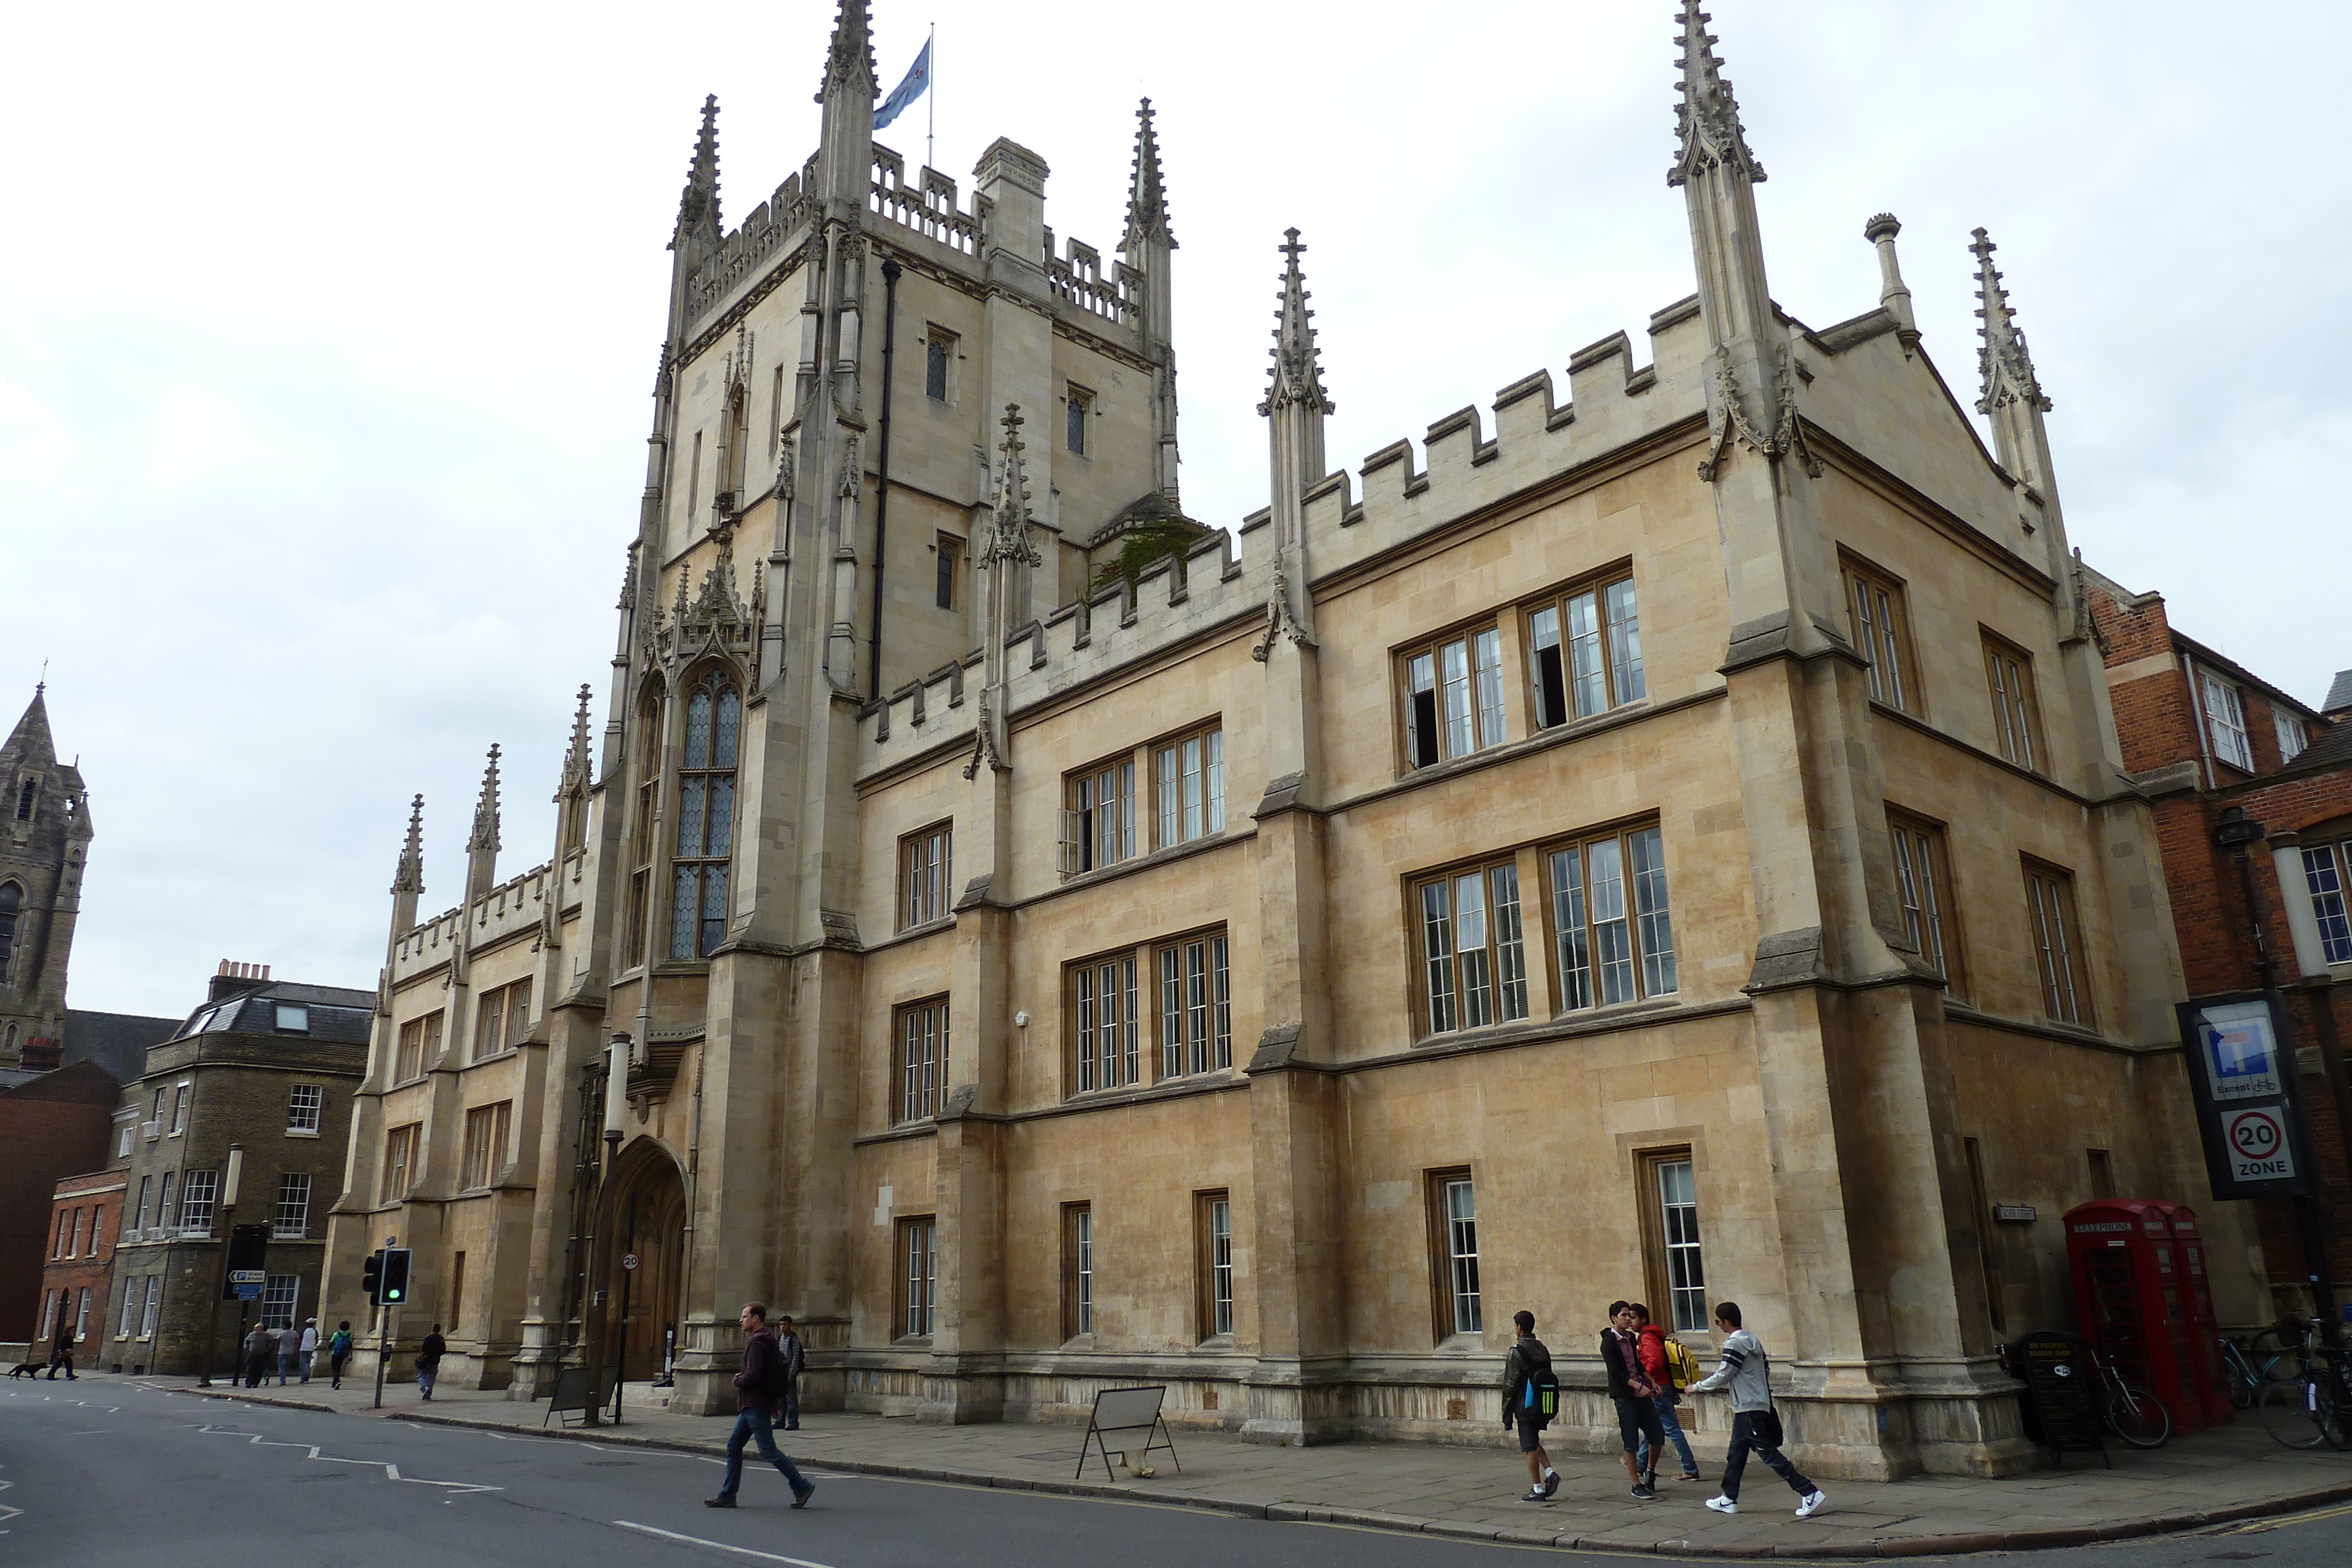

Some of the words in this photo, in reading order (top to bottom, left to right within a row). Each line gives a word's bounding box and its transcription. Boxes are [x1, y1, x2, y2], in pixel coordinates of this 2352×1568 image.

[2217, 1084, 2251, 1094] Except
[2238, 1125, 2273, 1146] 20
[2239, 1161, 2287, 1175] ZONE
[2076, 1222, 2130, 1232] TELEPHONE
[624, 1257, 637, 1265] 20
